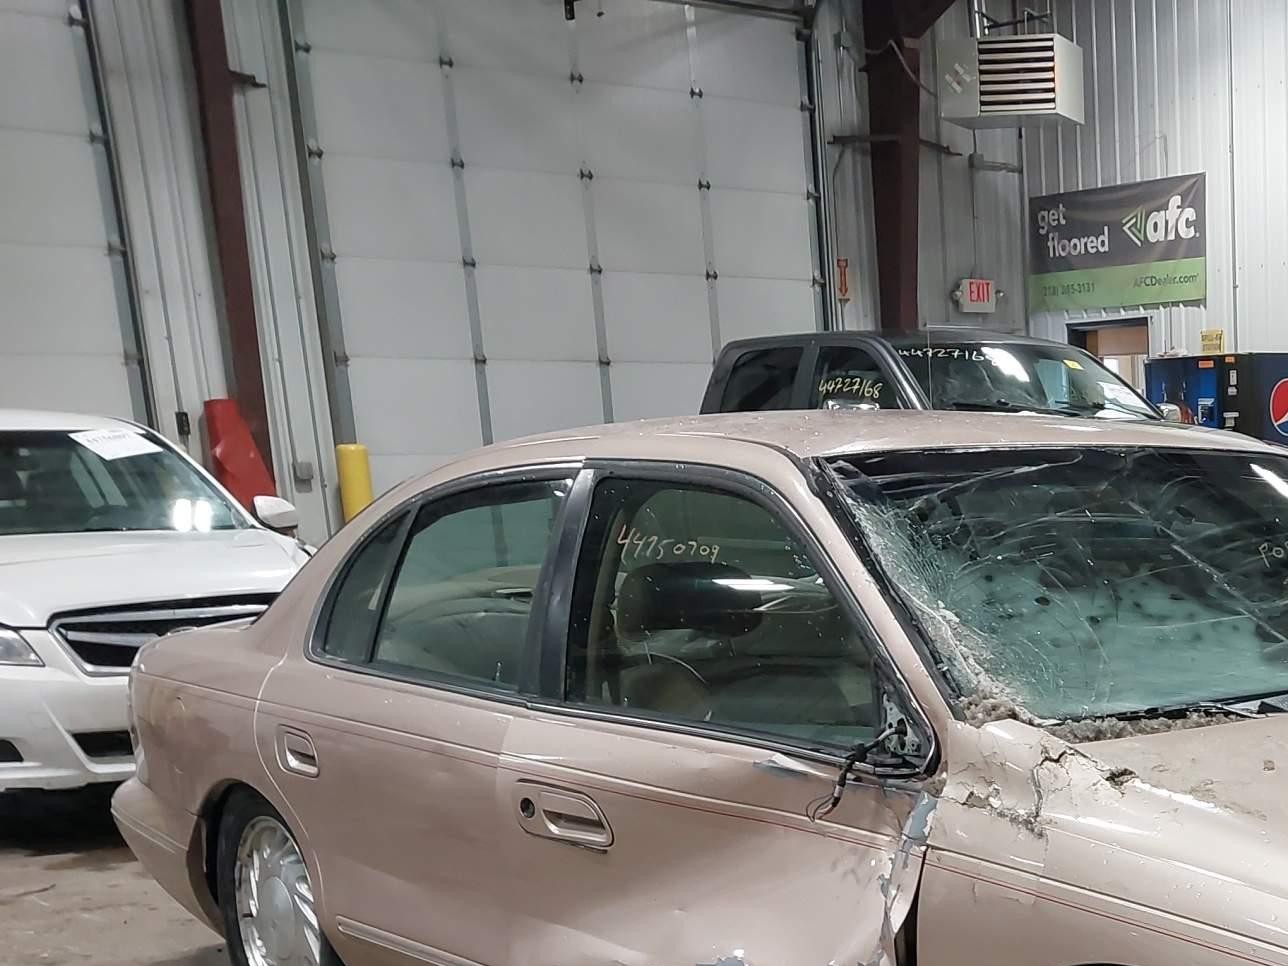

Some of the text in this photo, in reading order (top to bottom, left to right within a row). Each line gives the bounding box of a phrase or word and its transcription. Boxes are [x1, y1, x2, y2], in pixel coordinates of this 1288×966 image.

[1038, 203, 1066, 235] get
[1048, 225, 1109, 258] floored
[969, 281, 990, 303] EXIT
[617, 524, 720, 566] 44750709
